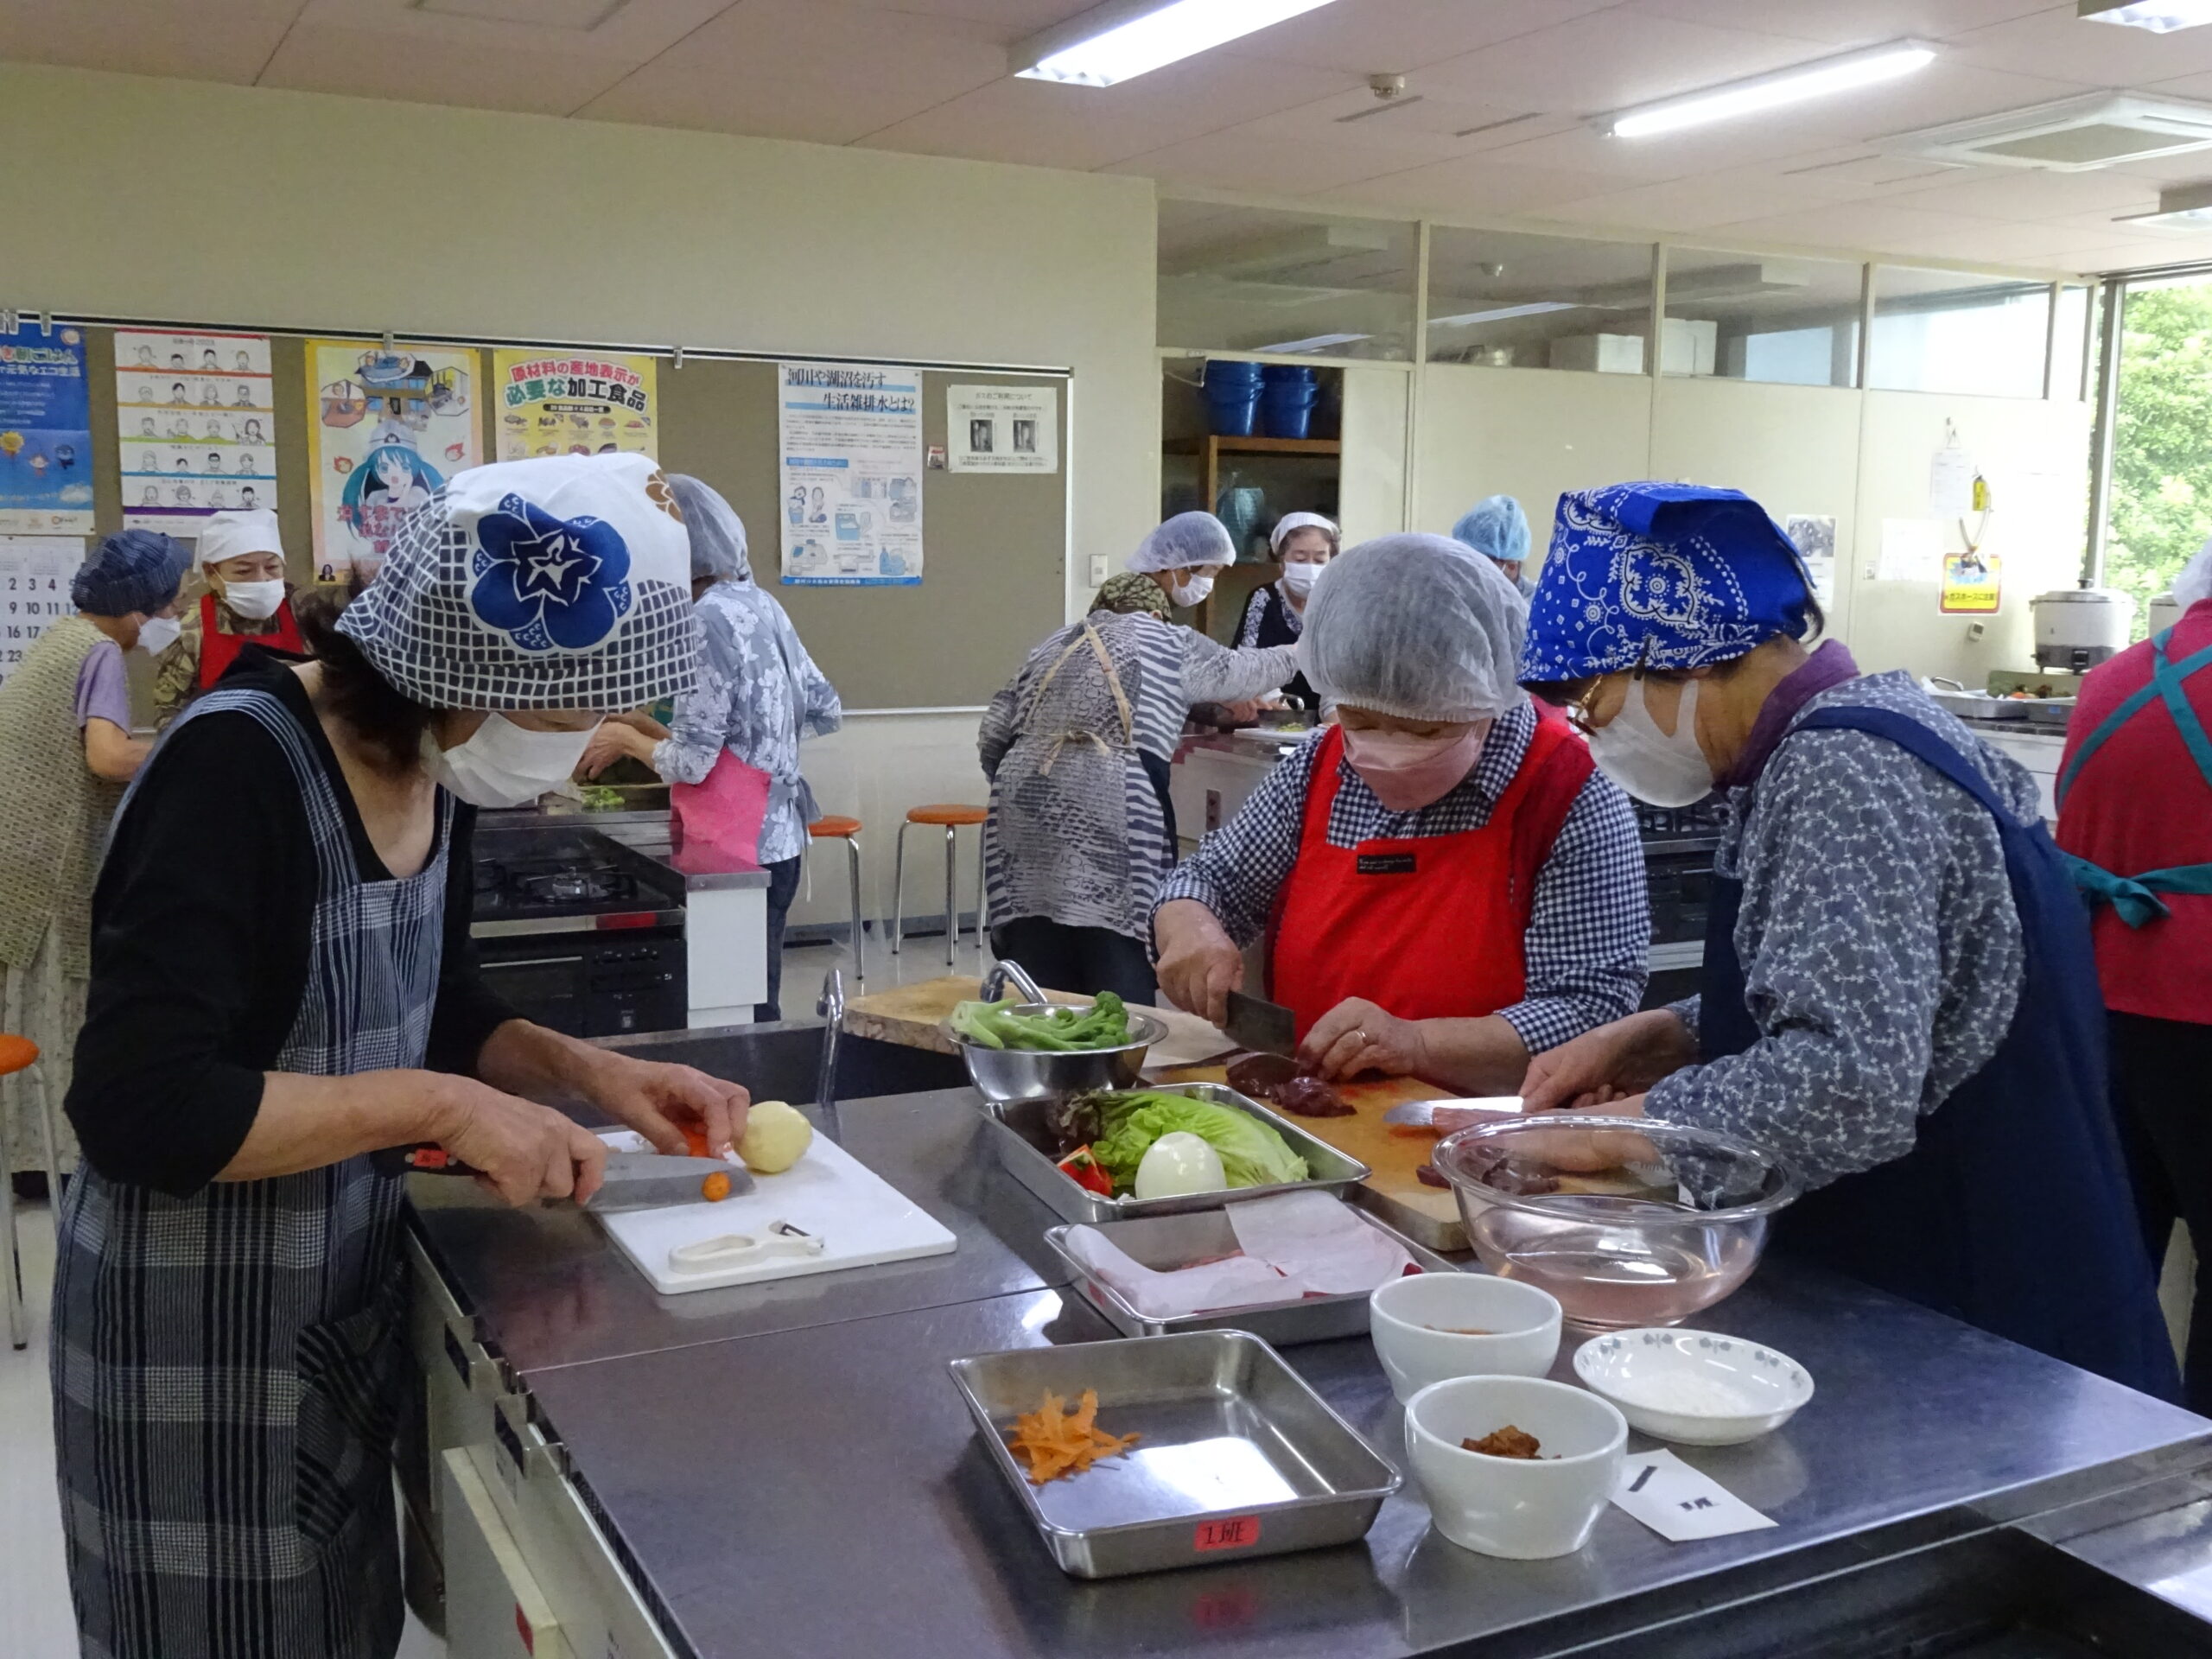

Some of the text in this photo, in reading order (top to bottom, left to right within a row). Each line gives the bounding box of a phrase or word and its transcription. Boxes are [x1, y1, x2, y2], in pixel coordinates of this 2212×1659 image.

[511, 360, 640, 385] 原材料の産地表示が
[787, 368, 887, 389] 河川や湖沼を汚す
[505, 378, 647, 412] 必要な加工食品
[9, 578, 16, 590] 2
[29, 579, 36, 591] 3
[48, 579, 56, 591] 4
[9, 601, 17, 614] 9
[26, 602, 40, 615] 10
[47, 602, 60, 615] 11
[8, 626, 40, 639] 16 17
[8, 650, 22, 663] 23
